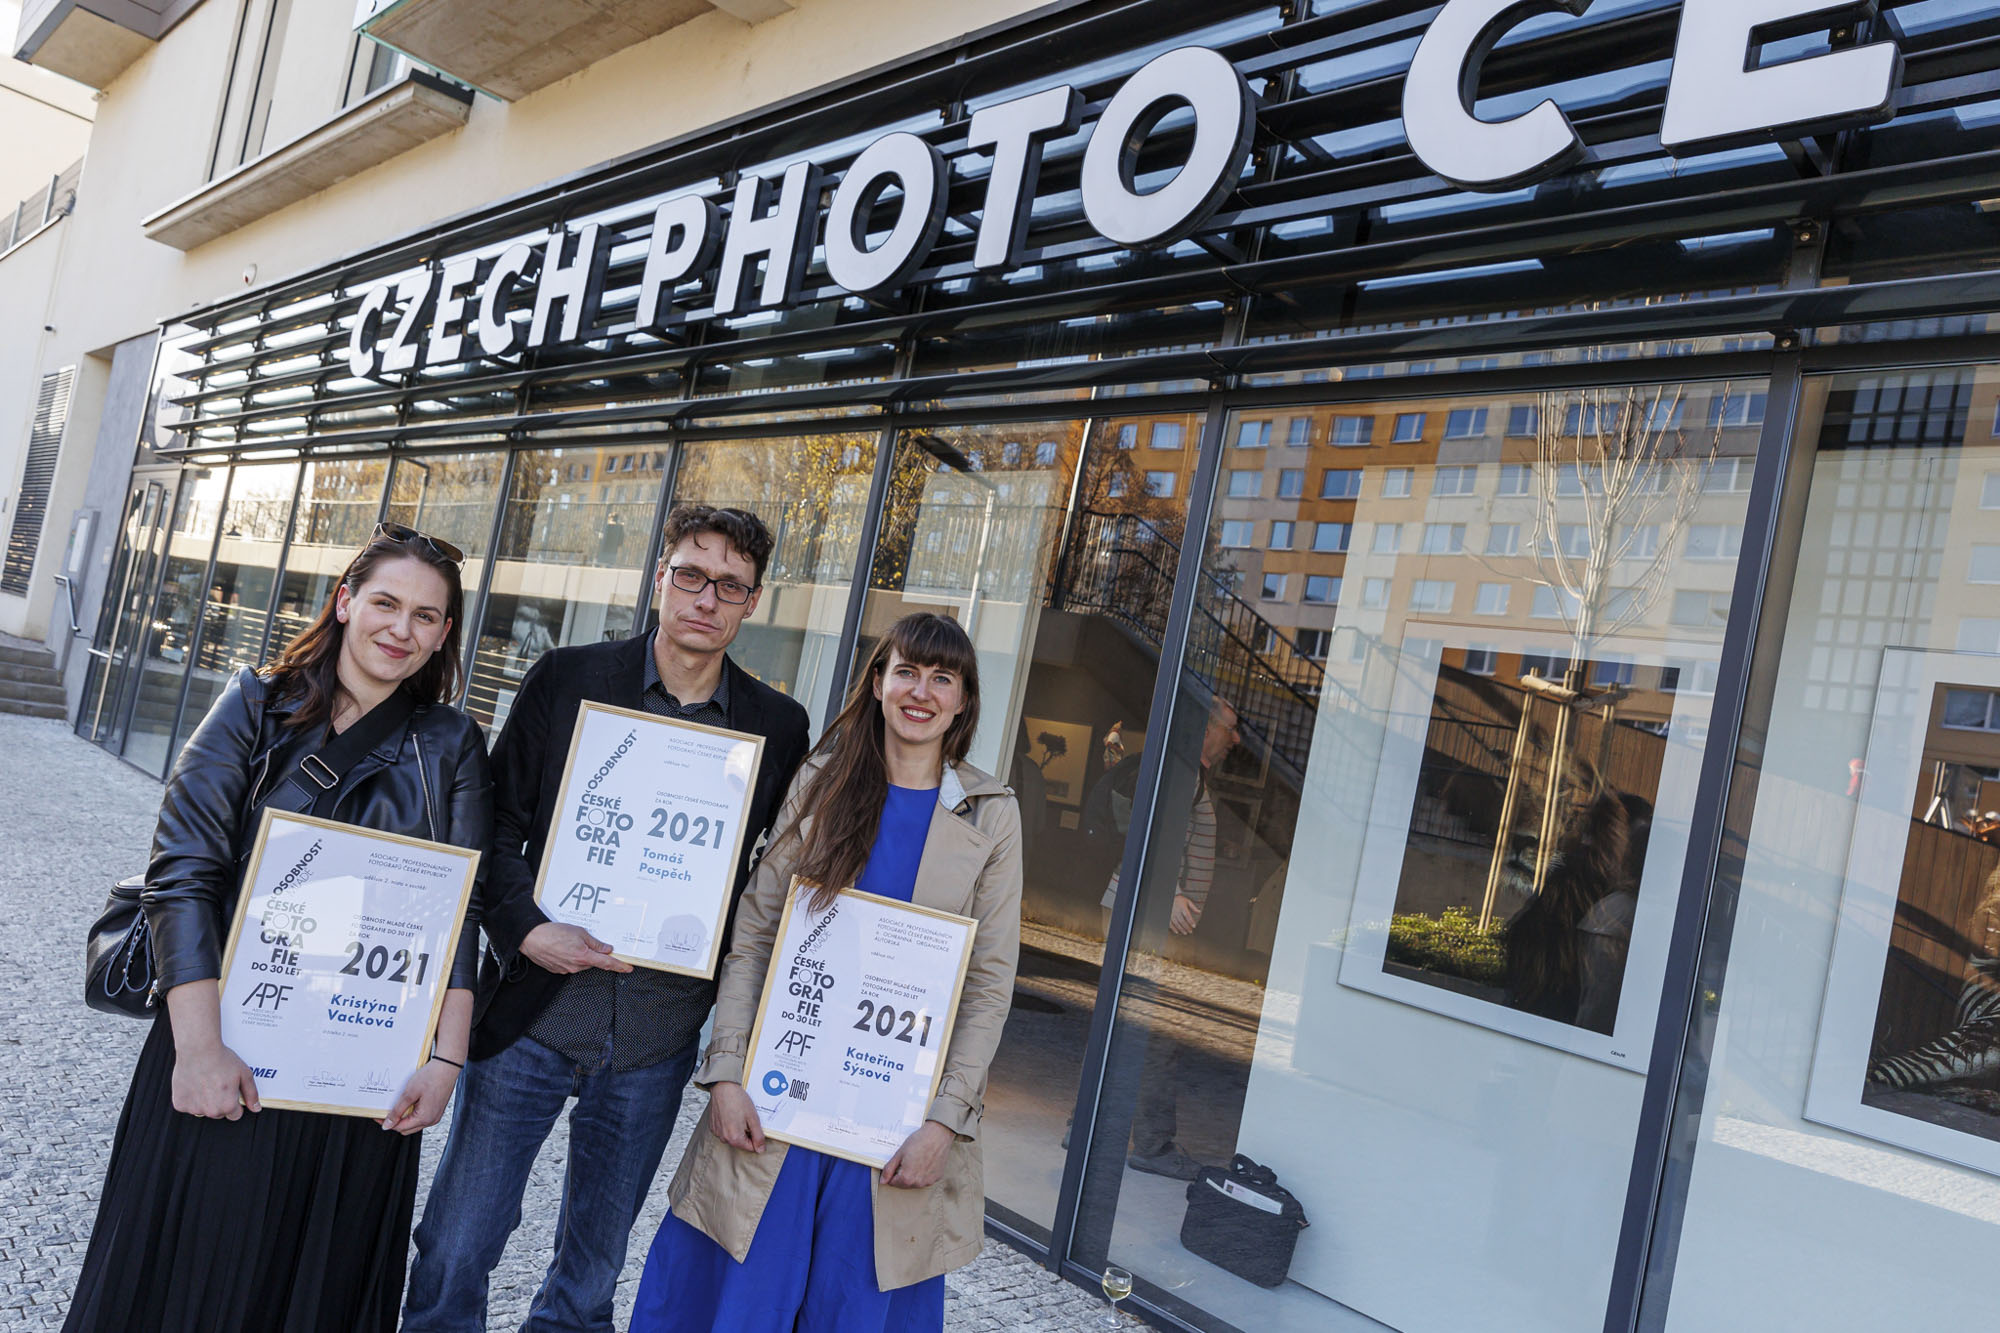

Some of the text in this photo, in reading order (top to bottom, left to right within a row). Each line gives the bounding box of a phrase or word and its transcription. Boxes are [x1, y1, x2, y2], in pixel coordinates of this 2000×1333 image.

[348, 222, 609, 381] CZECH
[635, 46, 1257, 329] PHOTO
[581, 790, 622, 810] ČESKÉ
[576, 805, 634, 832] FOTO
[647, 807, 725, 850] 2021
[575, 824, 621, 848] GRA
[586, 846, 617, 866] FIE
[643, 847, 685, 864] Tomáš
[639, 862, 692, 882] Pospěch
[267, 896, 306, 914] ČESKÉ
[559, 882, 610, 913] APF
[260, 910, 317, 934] FOTO
[260, 929, 304, 949] GRA
[270, 948, 300, 967] FIE
[340, 941, 429, 985] 2021
[794, 953, 825, 971] ČESKÉ
[251, 962, 302, 977] DO 30 LET
[789, 966, 834, 989] FOTO
[242, 982, 293, 1010] APF
[789, 982, 823, 1002] GRA
[331, 993, 397, 1013] Kristýna
[797, 1000, 820, 1018] FIE
[327, 1008, 395, 1029] Vacková
[782, 1011, 822, 1028] DO 30 LET
[853, 1000, 932, 1047] 2021
[774, 1030, 815, 1056] APF
[846, 1046, 904, 1071] Kateřina
[843, 1061, 891, 1082] Sýsová
